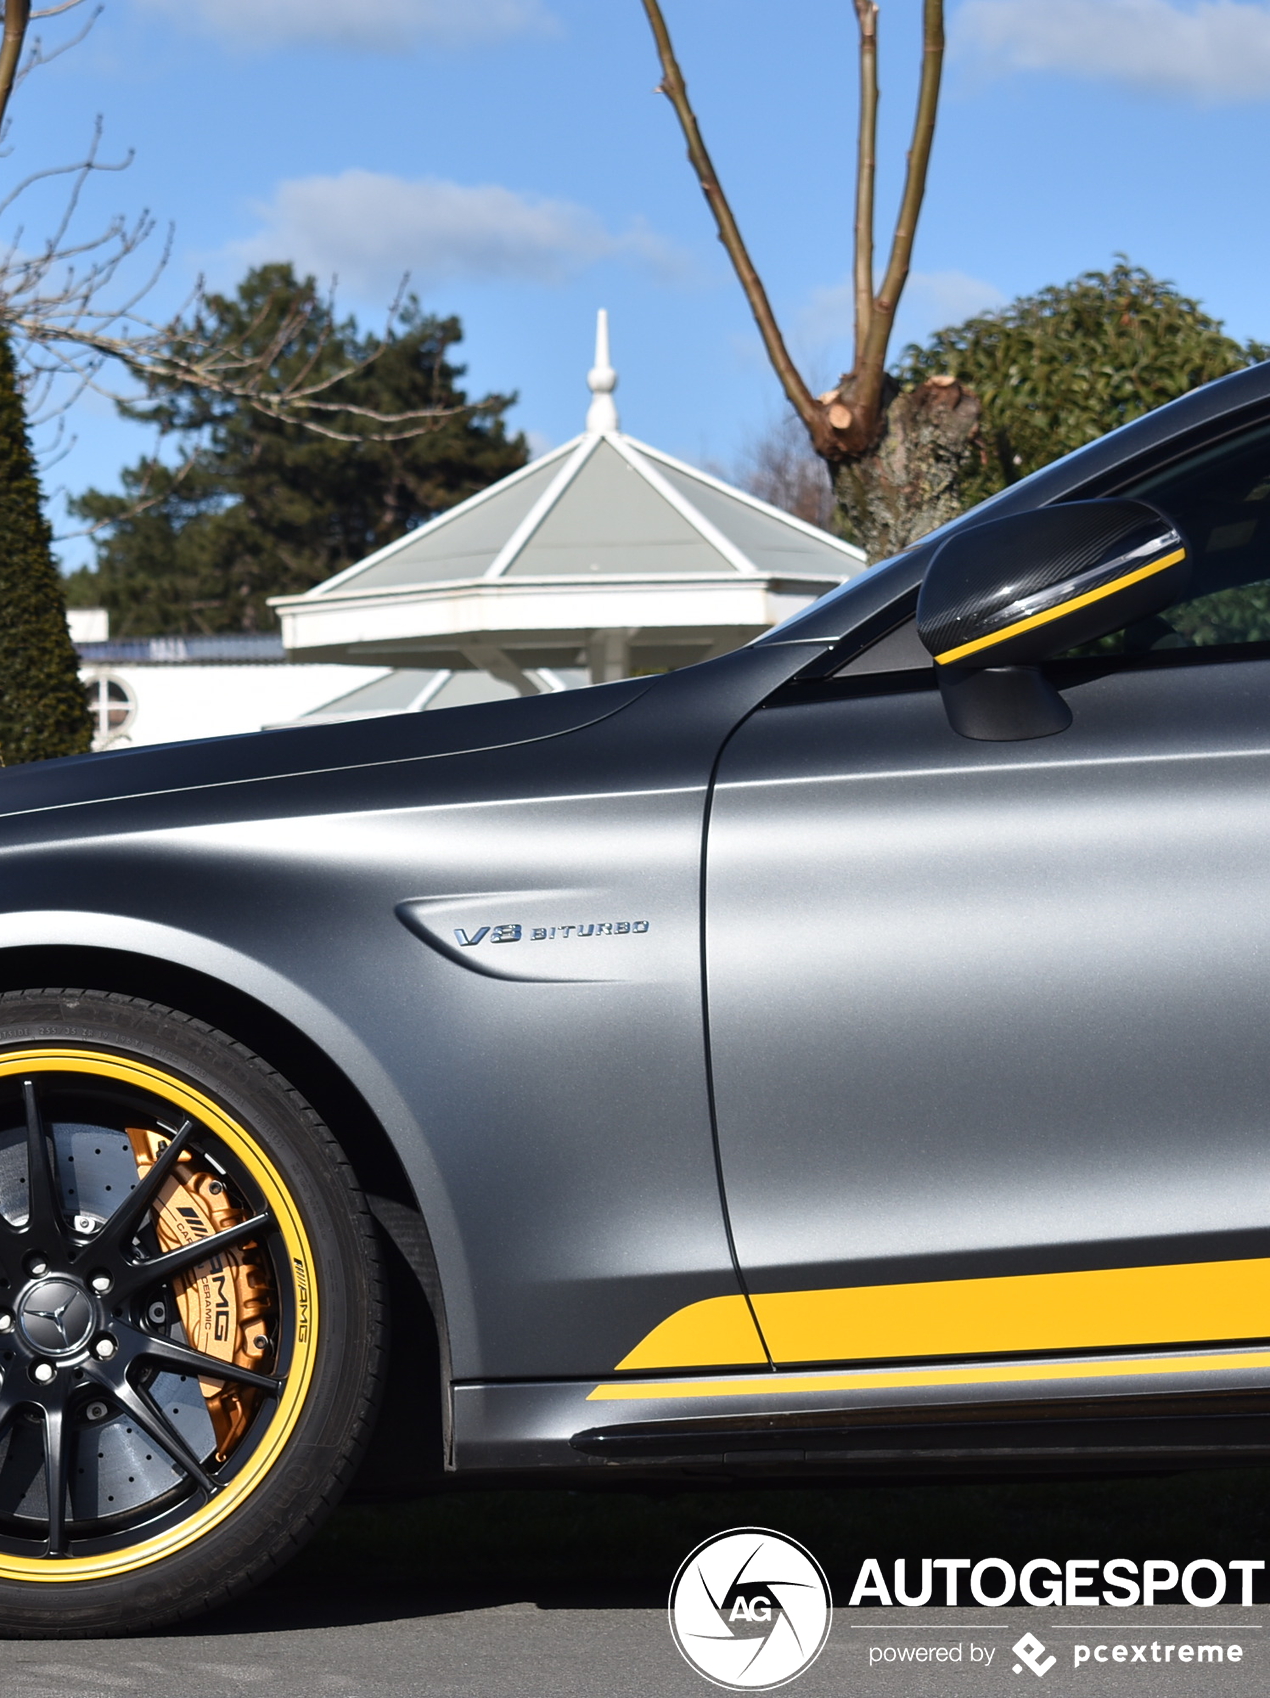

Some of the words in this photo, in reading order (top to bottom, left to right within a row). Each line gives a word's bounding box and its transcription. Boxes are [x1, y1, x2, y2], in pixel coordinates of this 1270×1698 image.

[454, 923, 523, 947] V8
[529, 920, 651, 941] BITURBO
[201, 1276, 212, 1330] CERAMIC
[210, 1254, 229, 1341] AMG
[298, 1284, 308, 1343] AMG
